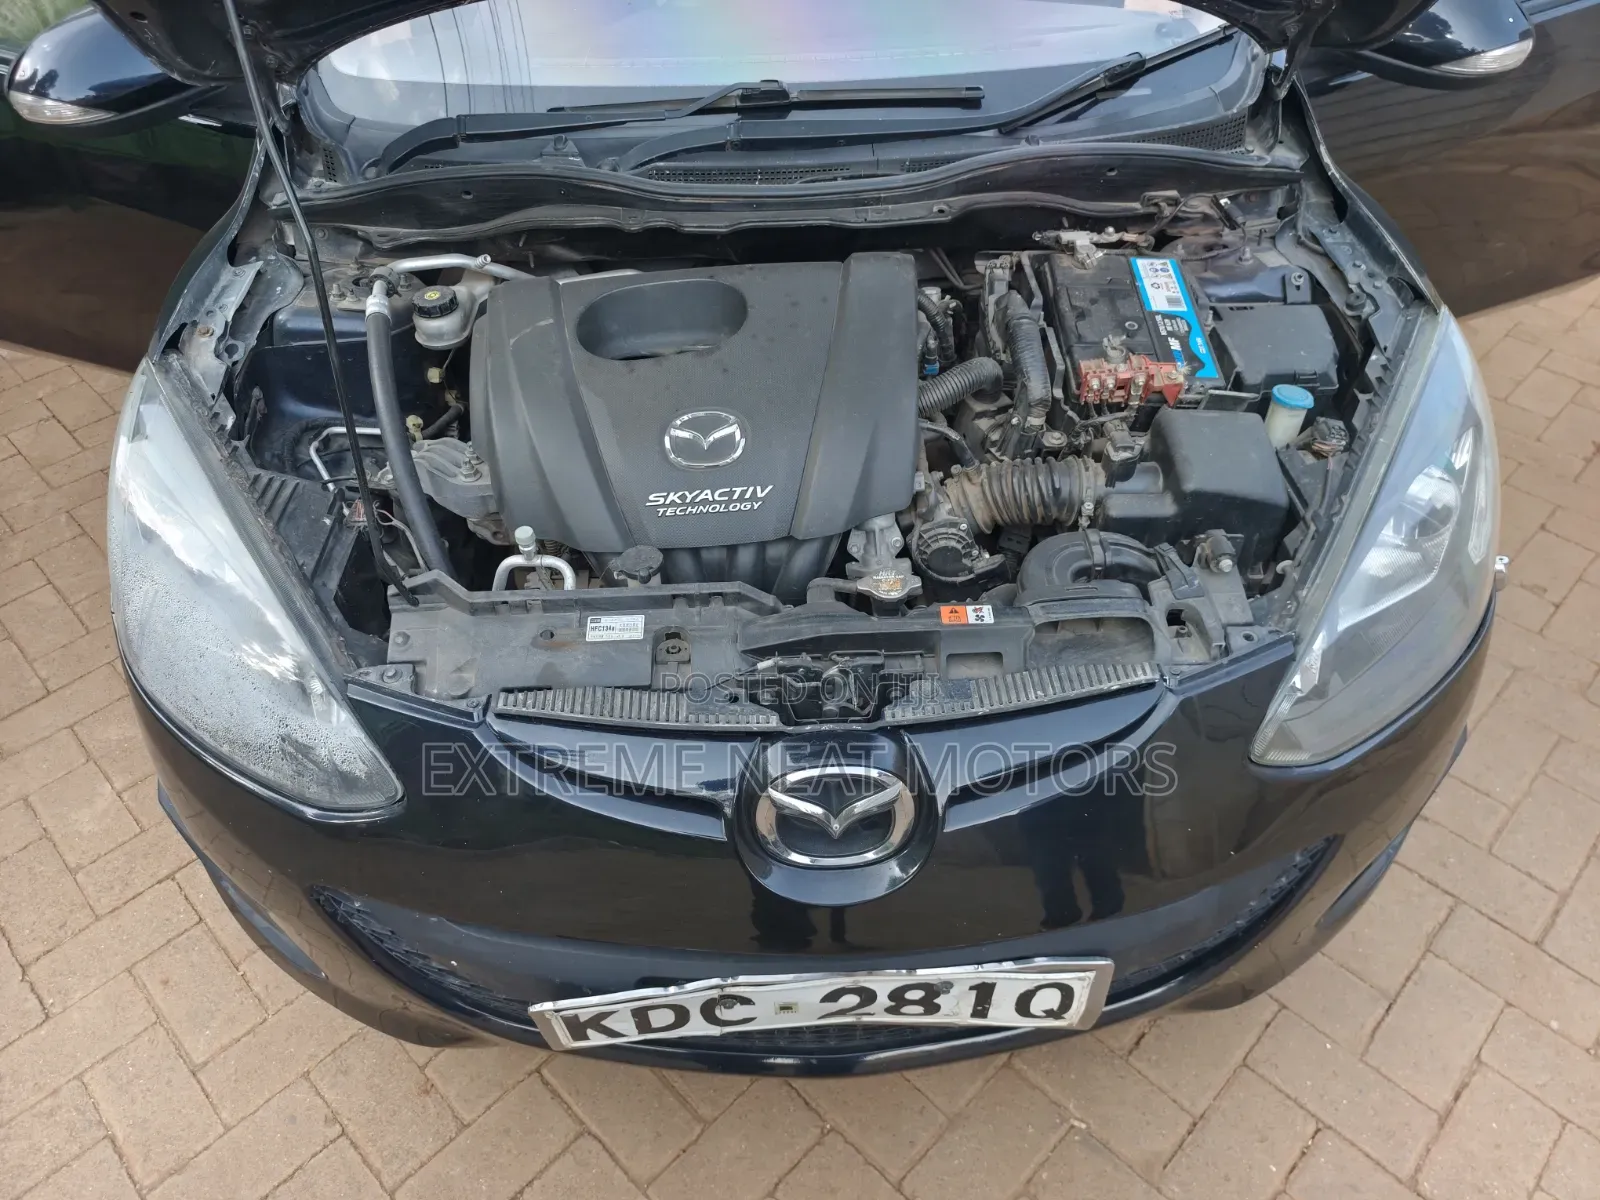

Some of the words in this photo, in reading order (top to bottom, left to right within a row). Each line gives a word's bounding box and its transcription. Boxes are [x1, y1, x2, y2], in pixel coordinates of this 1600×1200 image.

[645, 484, 774, 506] SKYACTIV
[656, 501, 763, 517] TECHNOLOGY
[590, 624, 615, 632] HFC134a
[560, 993, 758, 1042] KDC
[816, 981, 1076, 1021] 281Q
